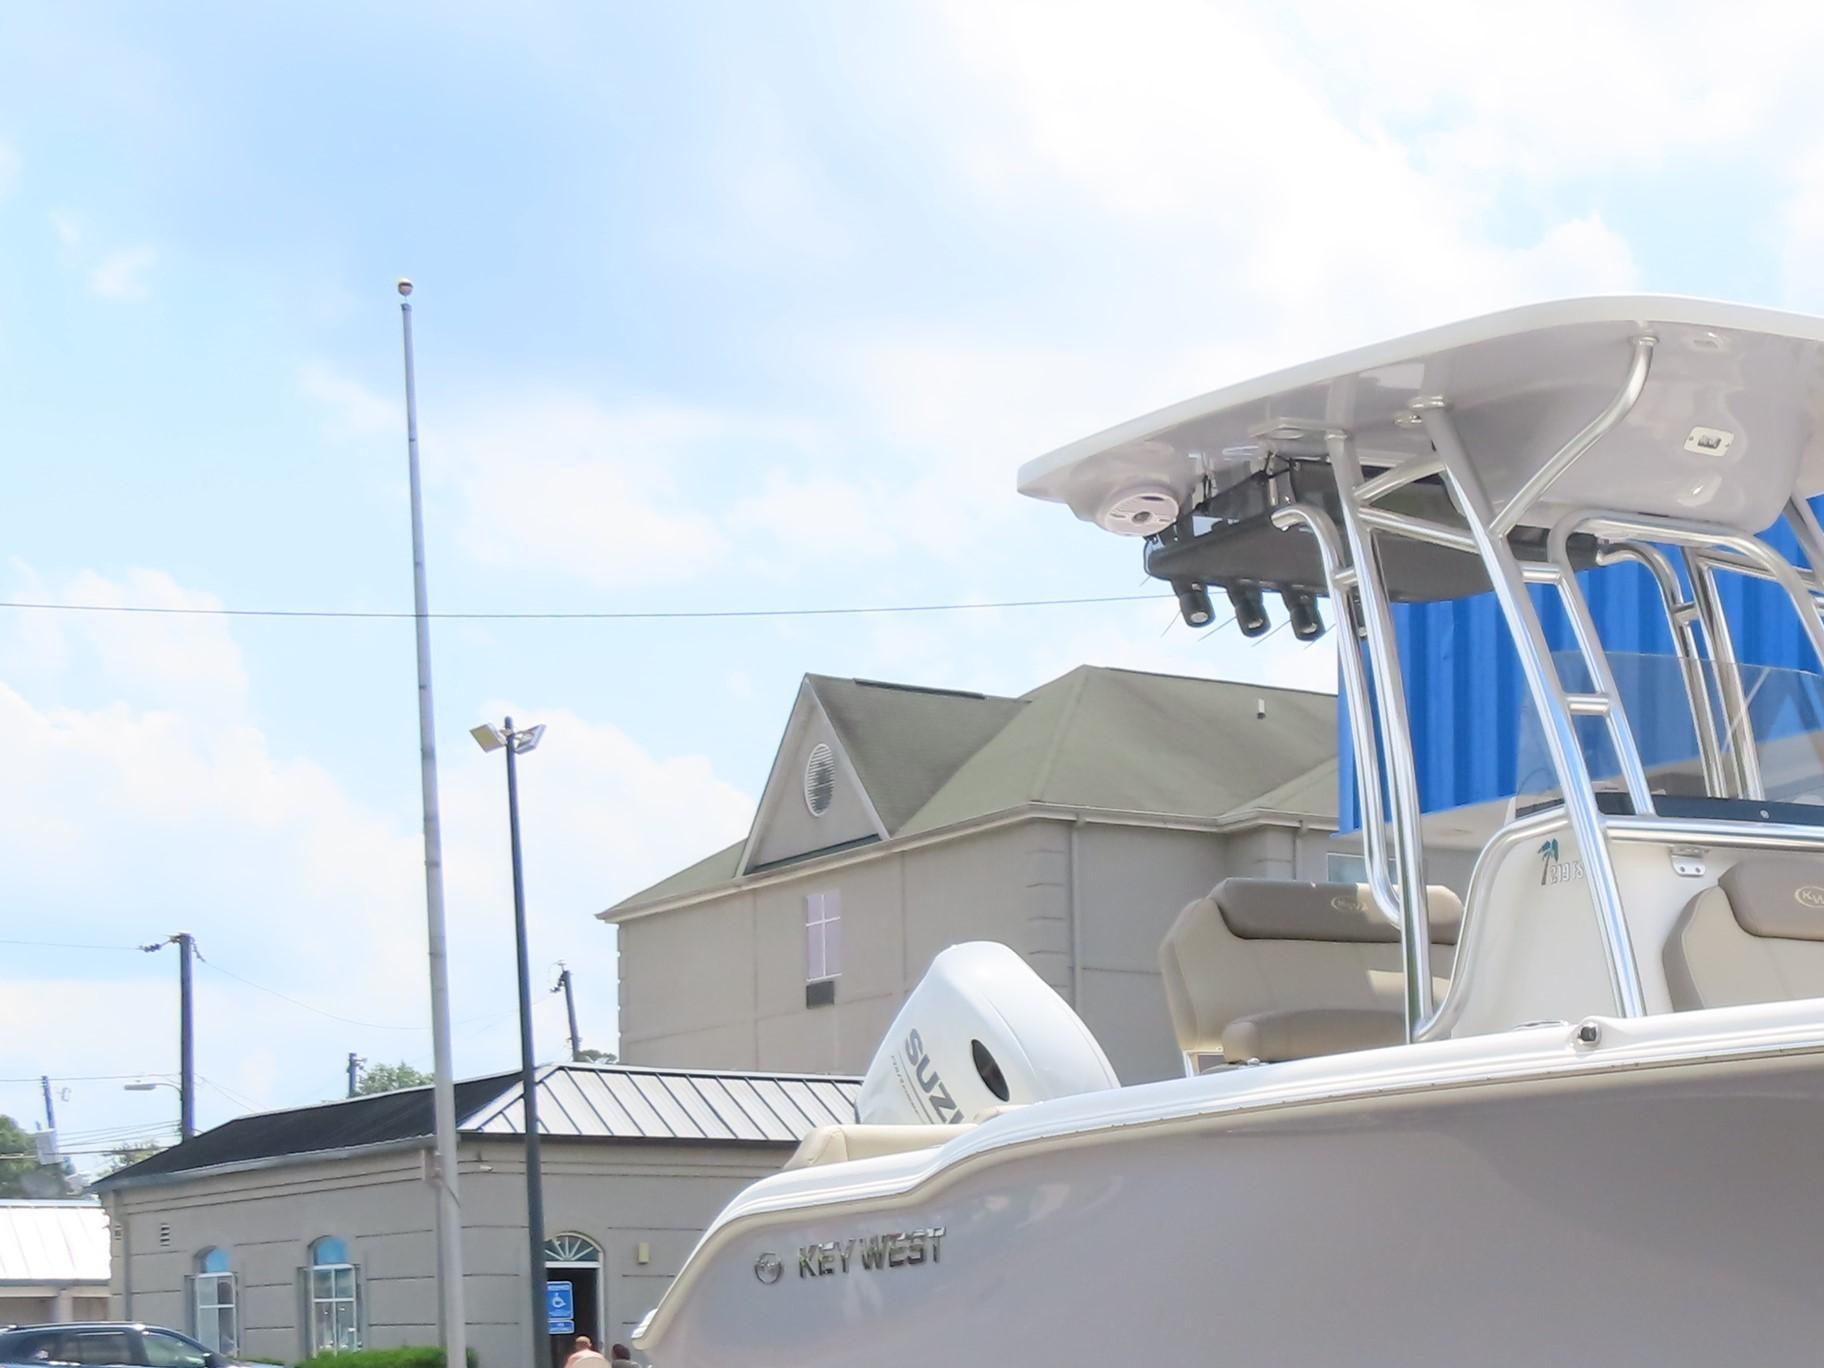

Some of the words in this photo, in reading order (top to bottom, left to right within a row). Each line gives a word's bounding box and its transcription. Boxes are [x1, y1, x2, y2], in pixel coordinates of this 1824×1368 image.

[905, 1028, 965, 1125] SUZ
[799, 1239, 857, 1279] KEY
[860, 1226, 946, 1272] WEST
